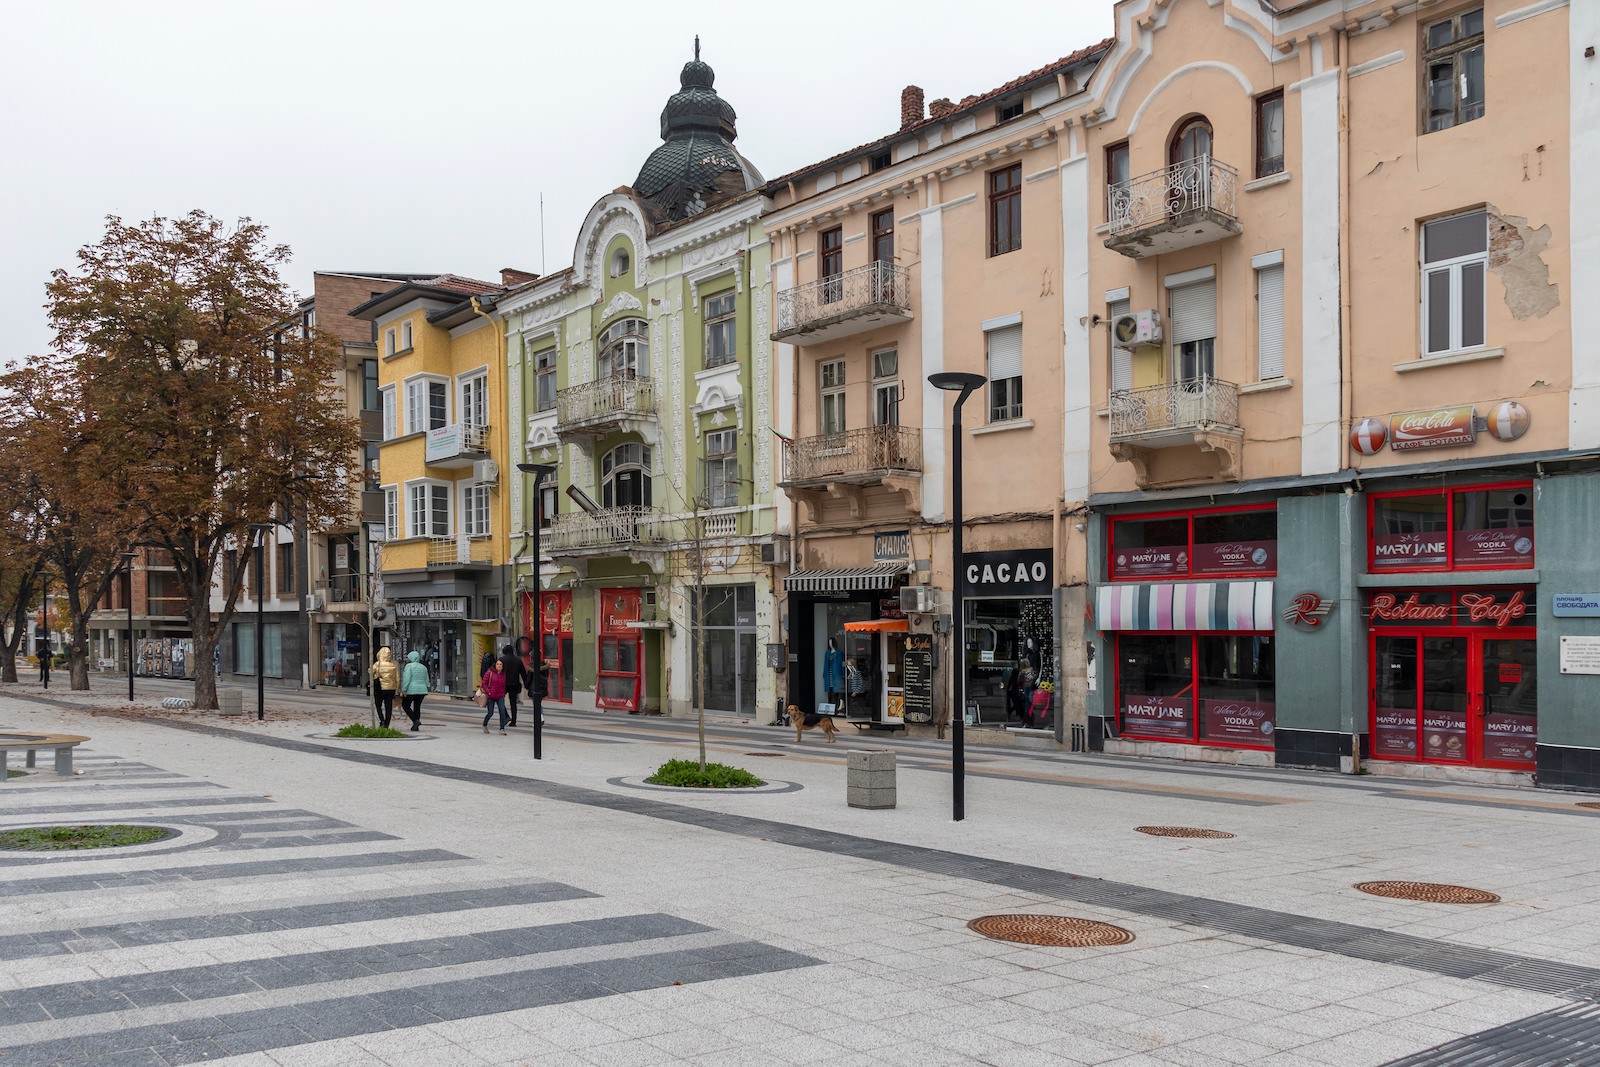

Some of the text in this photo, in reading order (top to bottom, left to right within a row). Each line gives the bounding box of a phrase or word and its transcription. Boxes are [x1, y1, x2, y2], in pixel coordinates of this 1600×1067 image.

[1396, 435, 1472, 449] КАФЕ "РОТАНА"
[1375, 542, 1446, 556] MARY JANE
[1477, 541, 1506, 549] VODKA
[1132, 553, 1171, 563] MARY JANE
[966, 561, 1047, 584] CACAO
[1371, 590, 1526, 629] Rotana Cafe
[1128, 704, 1184, 719] MARY JANE
[1224, 717, 1254, 726] VODKA
[1397, 718, 1416, 726] JANE
[1424, 719, 1466, 729] MARY JANE
